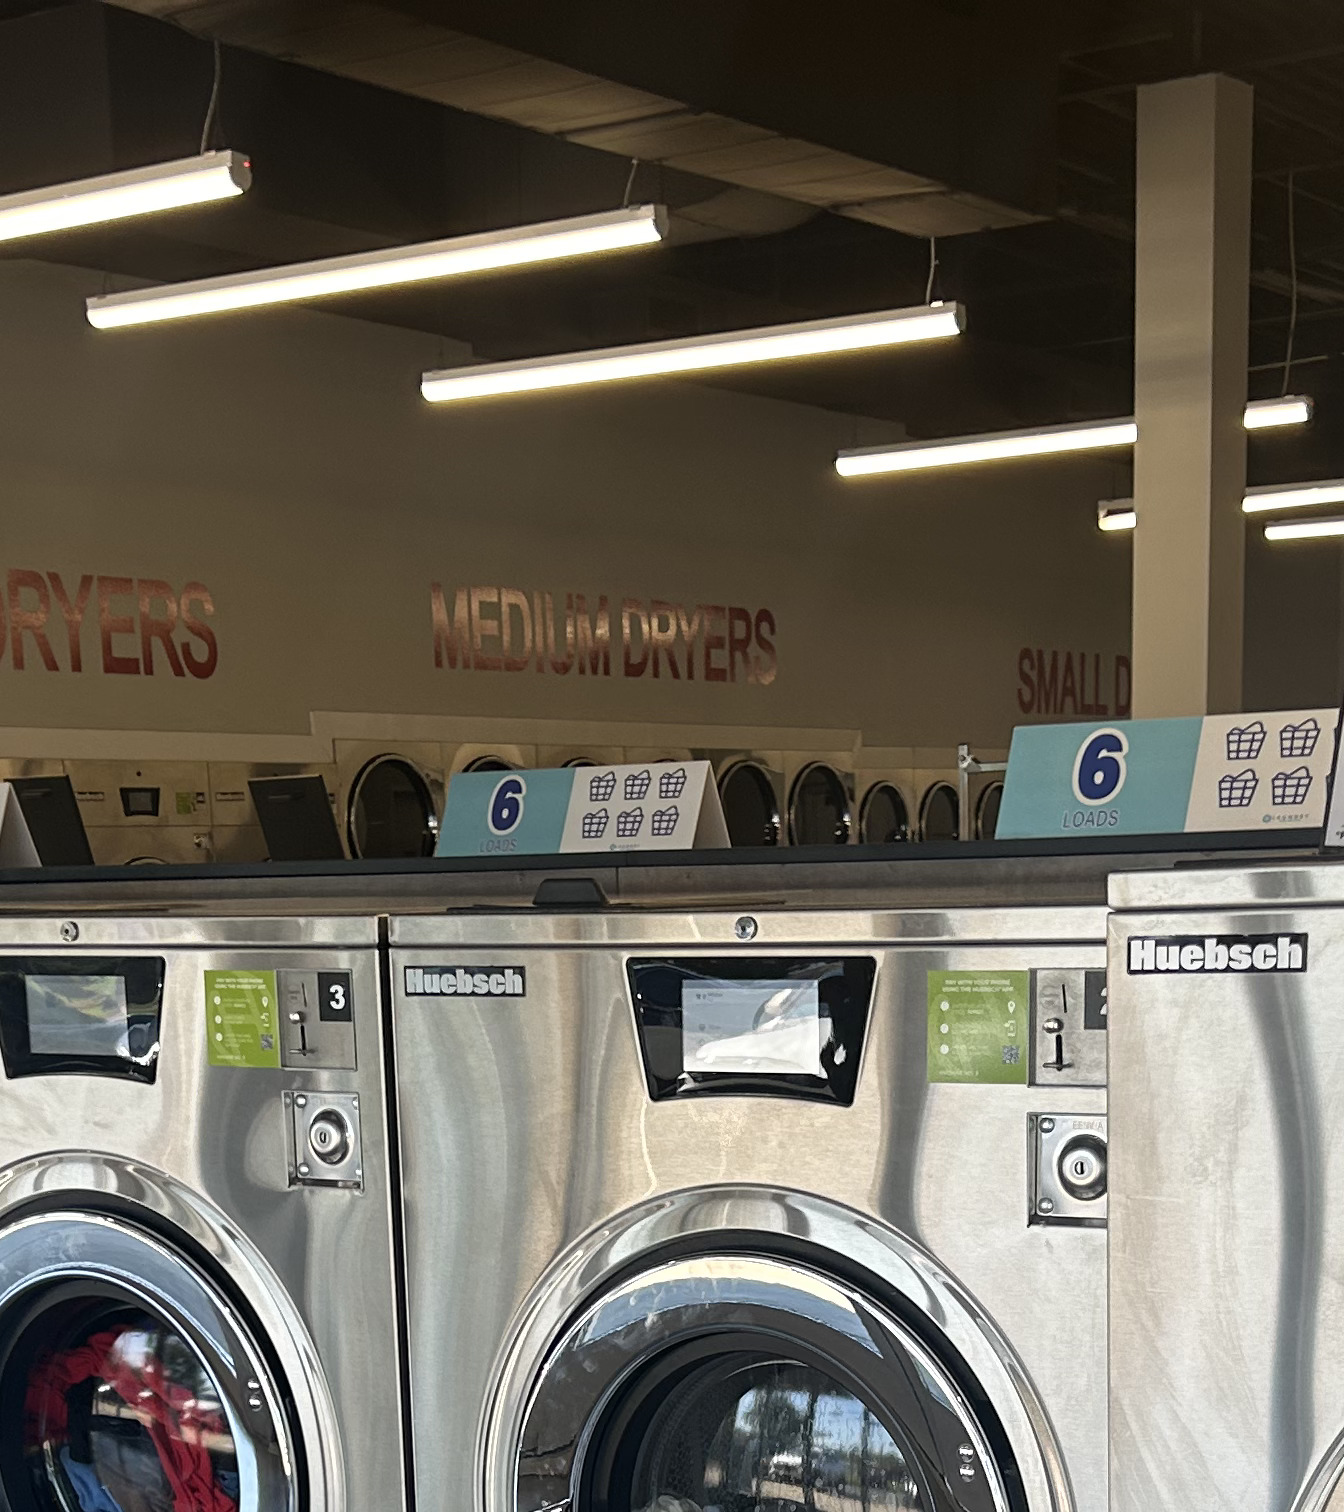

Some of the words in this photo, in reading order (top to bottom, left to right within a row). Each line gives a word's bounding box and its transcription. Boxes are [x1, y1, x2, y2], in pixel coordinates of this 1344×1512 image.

[431, 582, 610, 676] MEDIUM
[621, 597, 777, 685] DRYERS
[1016, 648, 1108, 715] SMALL
[1076, 732, 1125, 801] 6
[490, 777, 524, 832] 6
[1062, 810, 1119, 828] LOADS
[1130, 936, 1303, 971] Huebsch
[329, 984, 346, 1011] 3
[406, 967, 524, 995] Huebsch
